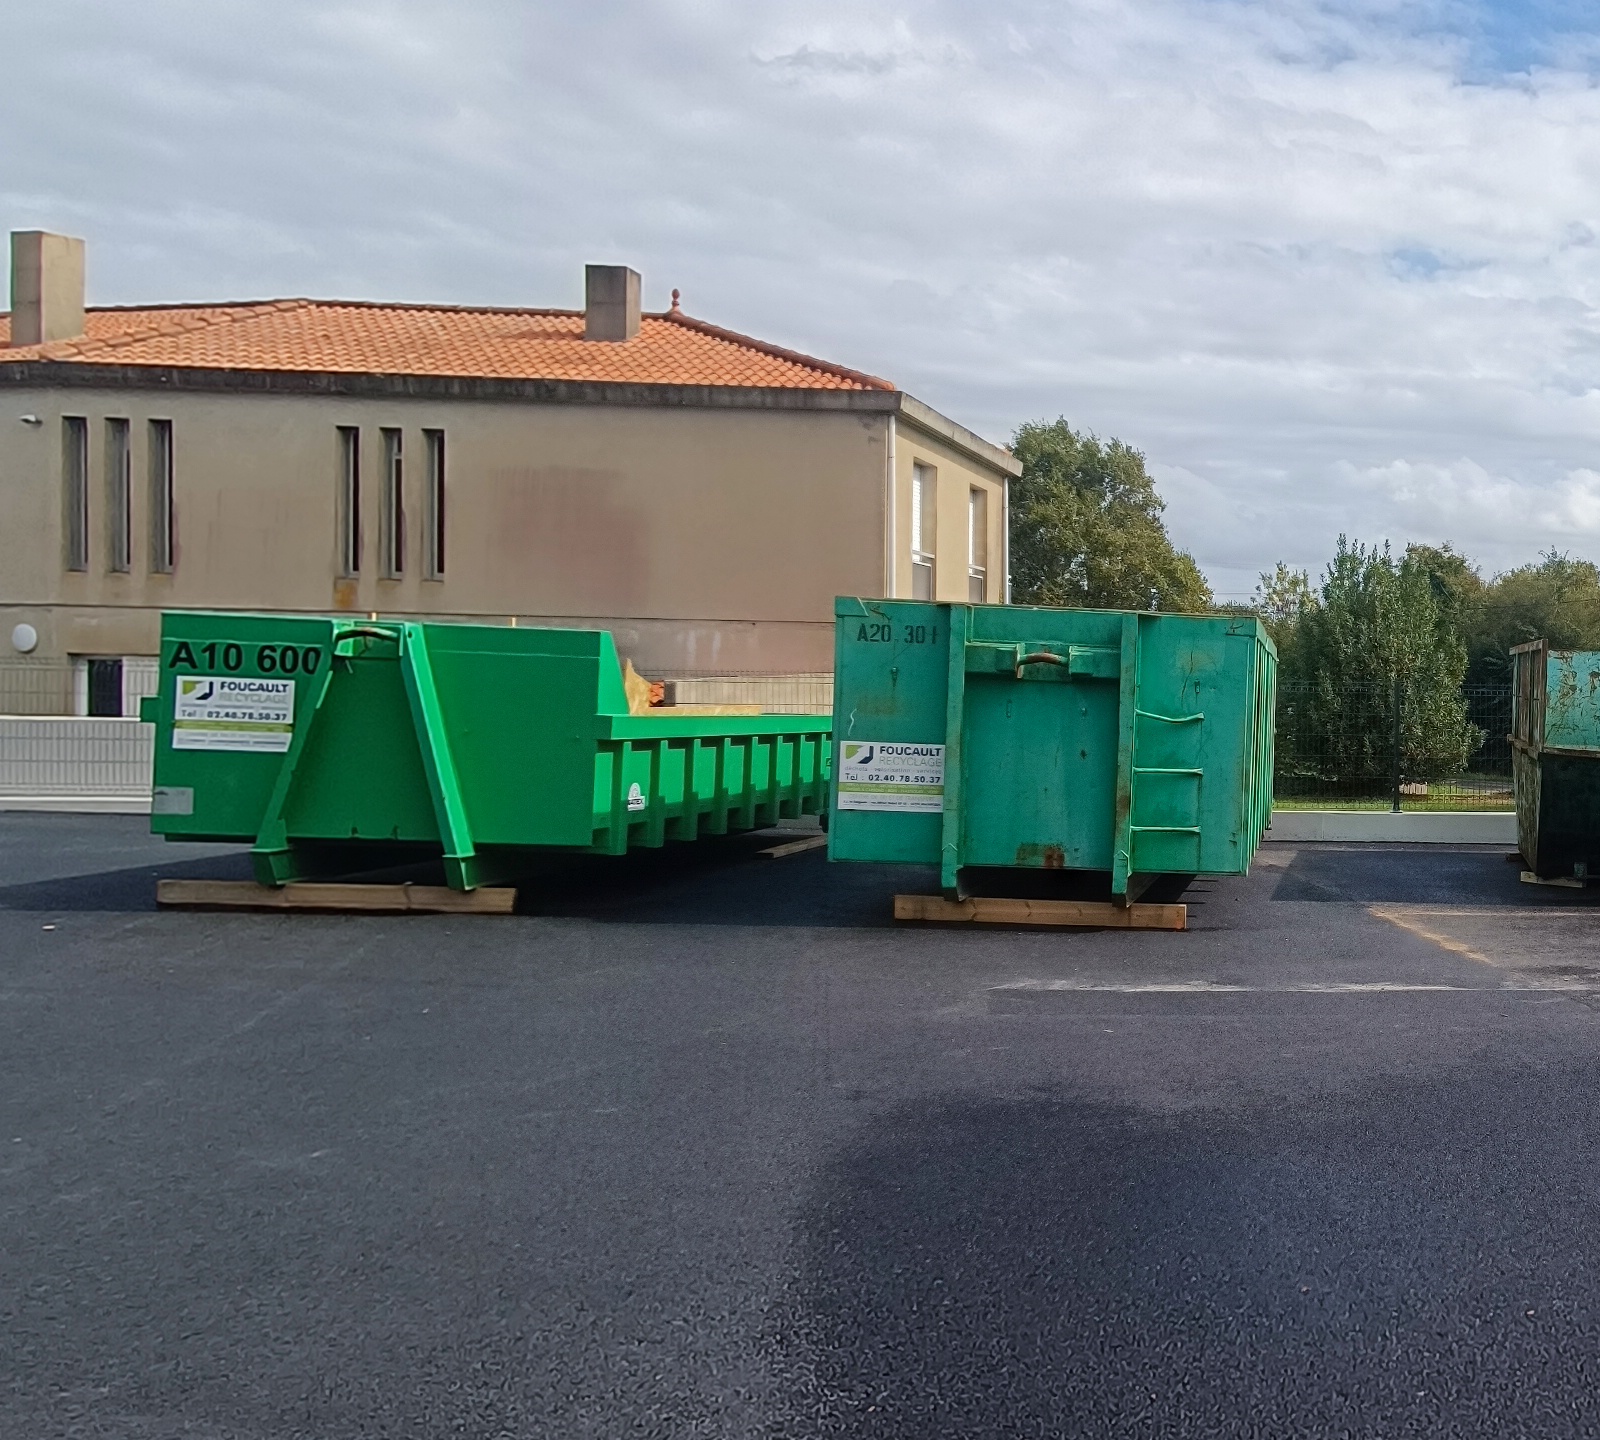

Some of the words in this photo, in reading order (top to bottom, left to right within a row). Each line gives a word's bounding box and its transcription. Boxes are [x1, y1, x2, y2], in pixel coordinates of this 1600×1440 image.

[857, 622, 892, 643] A20
[168, 641, 243, 672] A10
[256, 645, 322, 675] 600
[220, 681, 289, 693] FOUCAULT
[219, 692, 288, 704] RECYCLAGE
[879, 745, 942, 757] FOUCAULT
[879, 756, 943, 767] RECYCLAGE
[868, 774, 941, 784] 02.40.78.50.37
